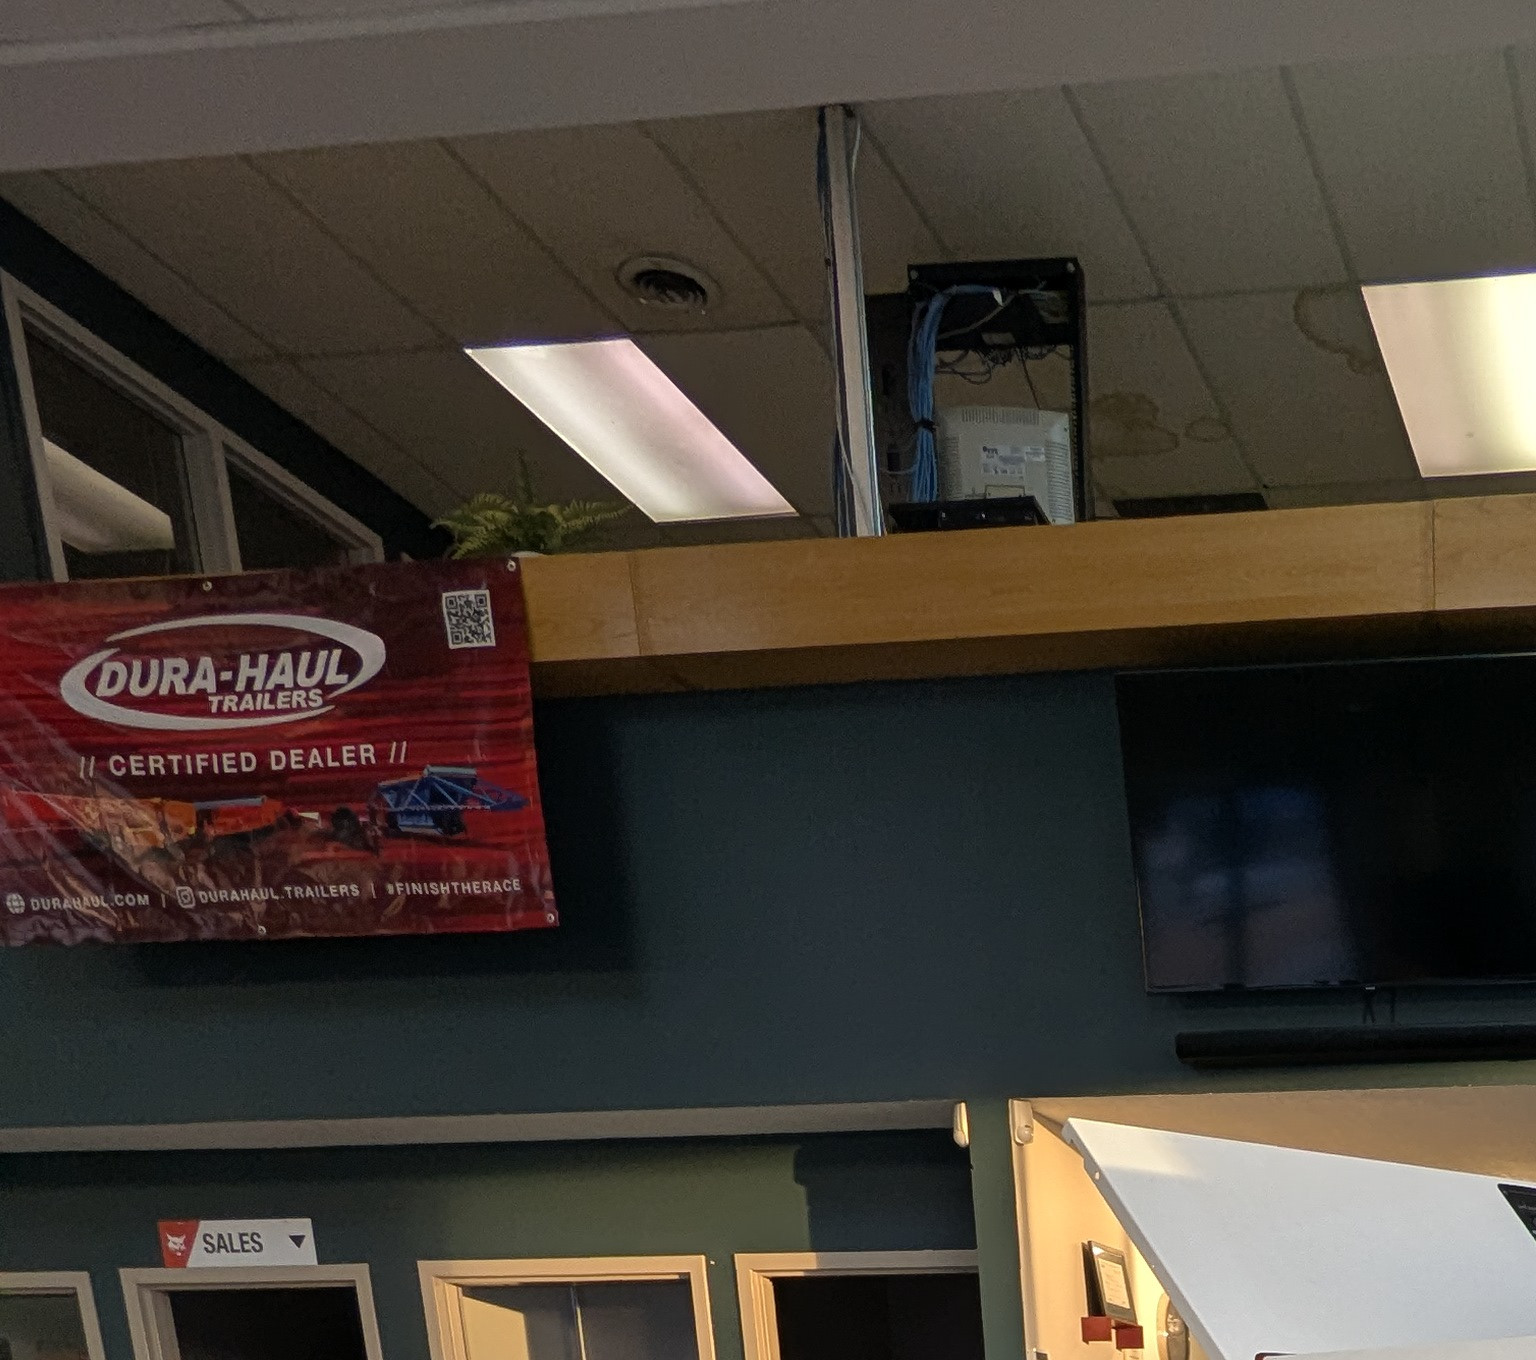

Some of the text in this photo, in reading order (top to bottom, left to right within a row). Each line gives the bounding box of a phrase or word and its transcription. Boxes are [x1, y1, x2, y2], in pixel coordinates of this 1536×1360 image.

[96, 648, 349, 698] DURA-HAUL
[208, 687, 324, 713] TRAILERS
[108, 751, 257, 776] CERTIFIED
[270, 743, 377, 771] DEALER
[386, 878, 522, 896] #FINISHTHERACE
[202, 1231, 264, 1254] SALES
